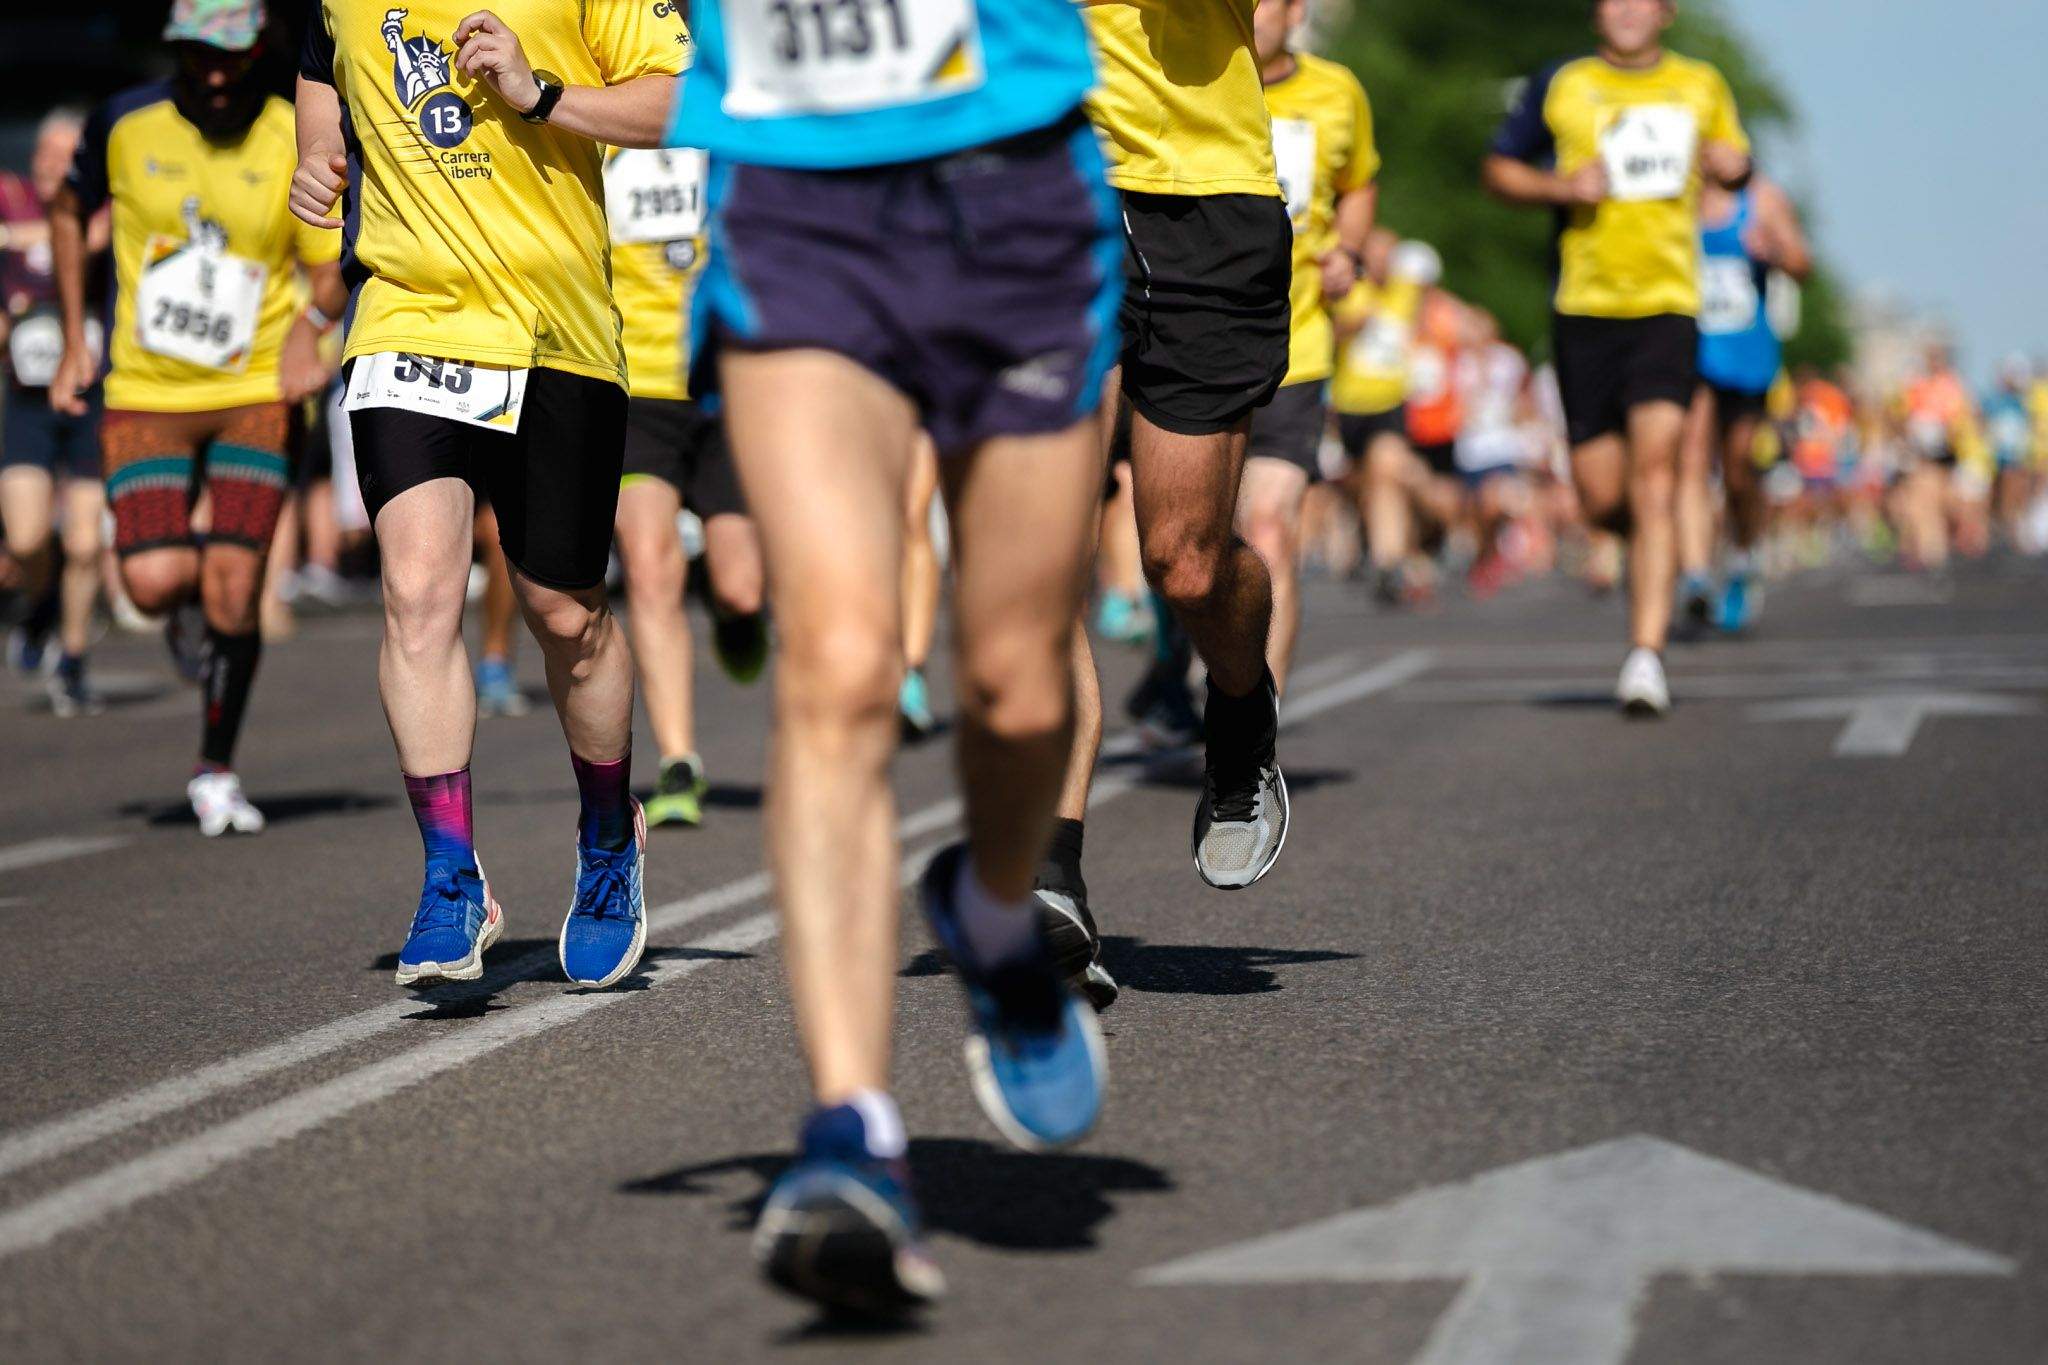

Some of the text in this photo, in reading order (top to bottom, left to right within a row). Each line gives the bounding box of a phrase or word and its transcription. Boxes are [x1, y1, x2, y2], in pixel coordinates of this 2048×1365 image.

[430, 105, 462, 134] 13
[440, 151, 490, 164] Carrera
[449, 165, 492, 179] iberty
[153, 298, 233, 345] 2956
